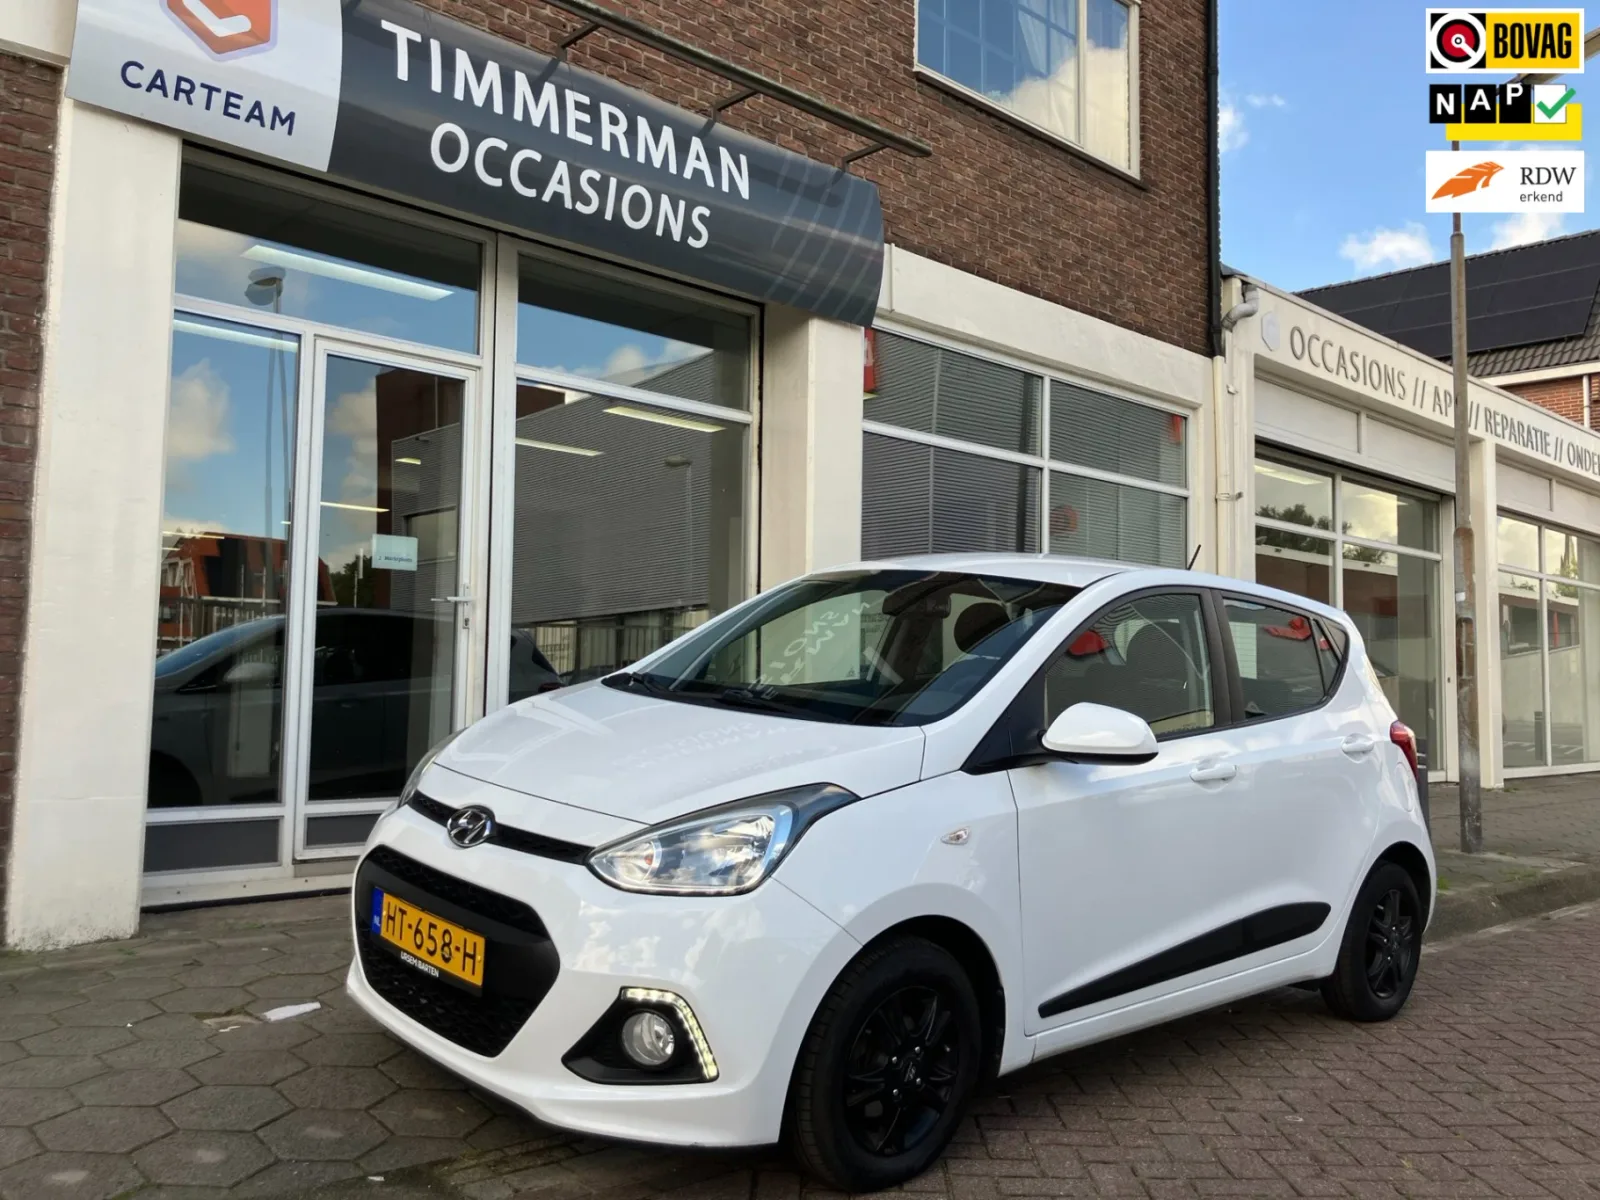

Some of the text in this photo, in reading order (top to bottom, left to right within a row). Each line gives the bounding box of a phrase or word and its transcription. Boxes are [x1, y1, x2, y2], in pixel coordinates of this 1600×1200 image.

[119, 59, 297, 137] CARTEAM
[379, 19, 751, 200] TIMMERMAN
[429, 121, 713, 250] OCCASIONS
[1289, 325, 1407, 401] OCCASIONS
[1484, 406, 1552, 458] REPARATIE
[385, 900, 478, 976] HT-658-H
